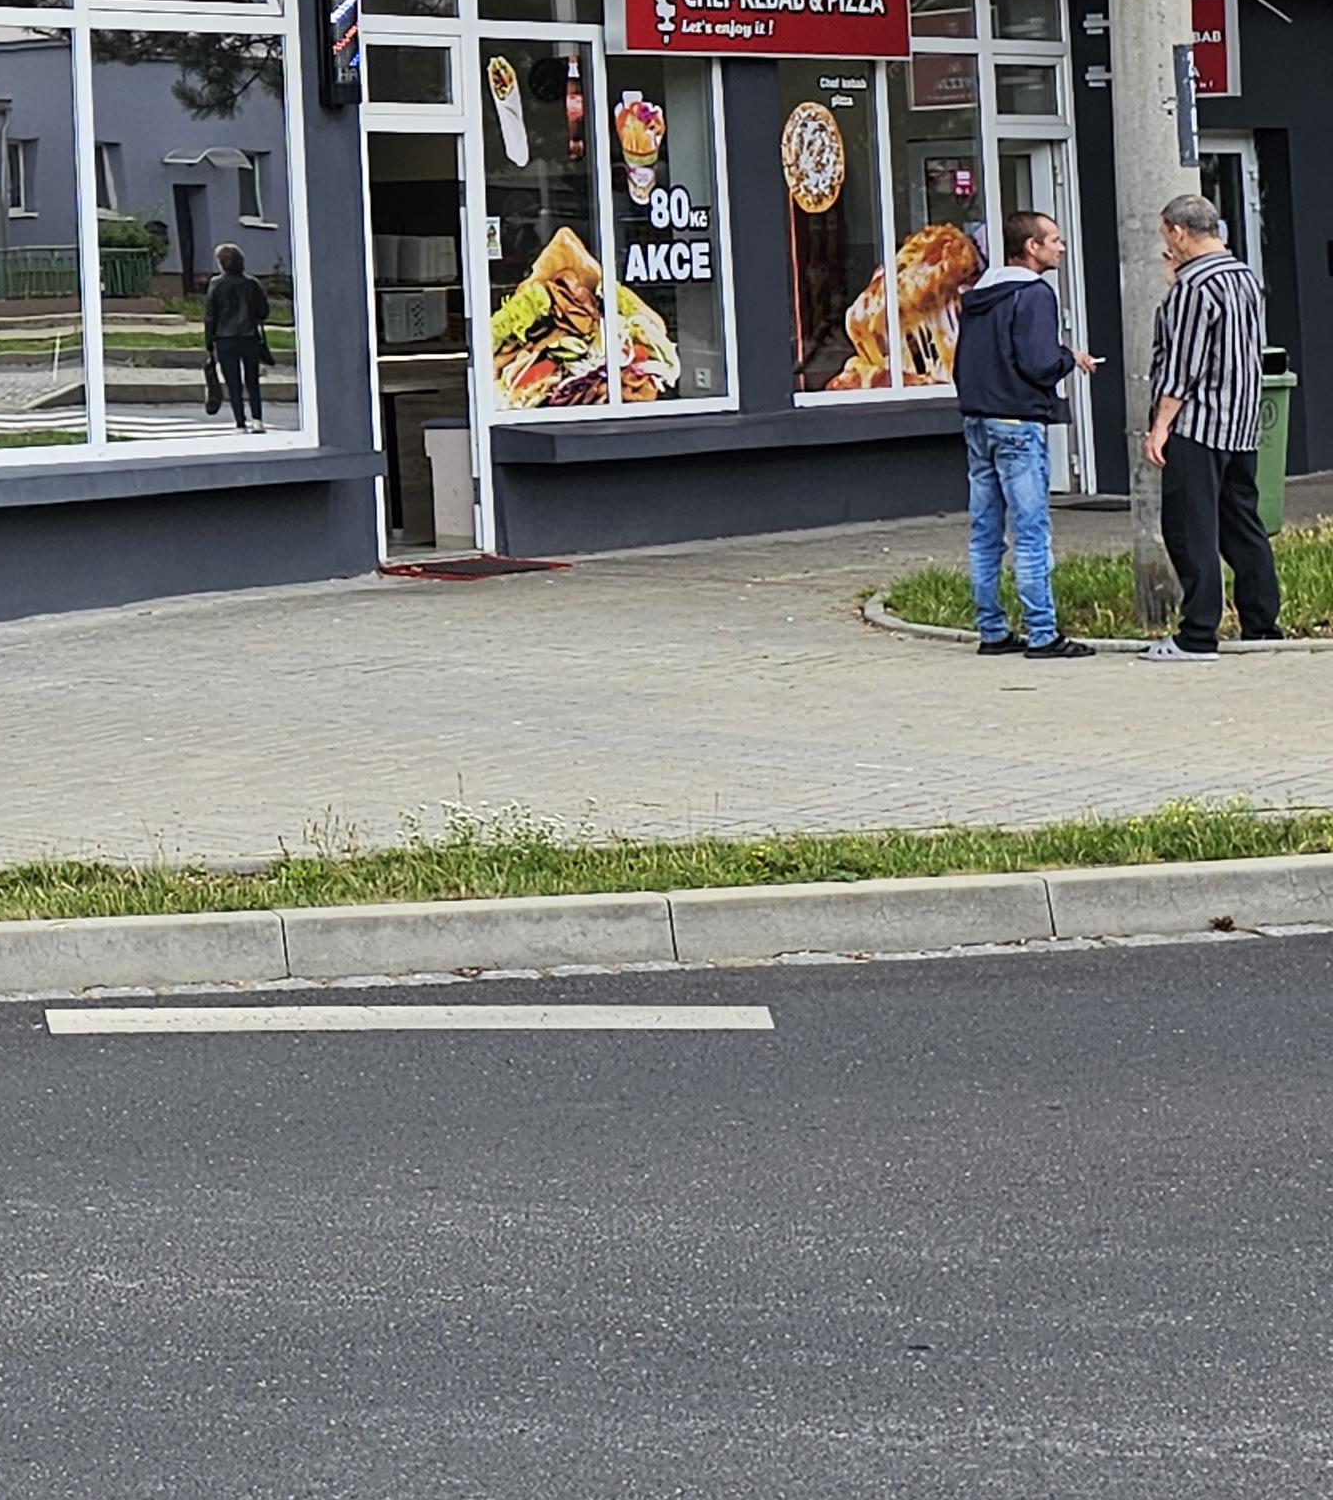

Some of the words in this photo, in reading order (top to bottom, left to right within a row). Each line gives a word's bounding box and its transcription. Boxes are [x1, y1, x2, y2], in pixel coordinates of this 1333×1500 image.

[681, 19, 712, 35] Let's
[714, 20, 752, 39] enjoy
[754, 20, 766, 35] it
[1192, 30, 1222, 43] BAB
[625, 242, 712, 282] AKCE
